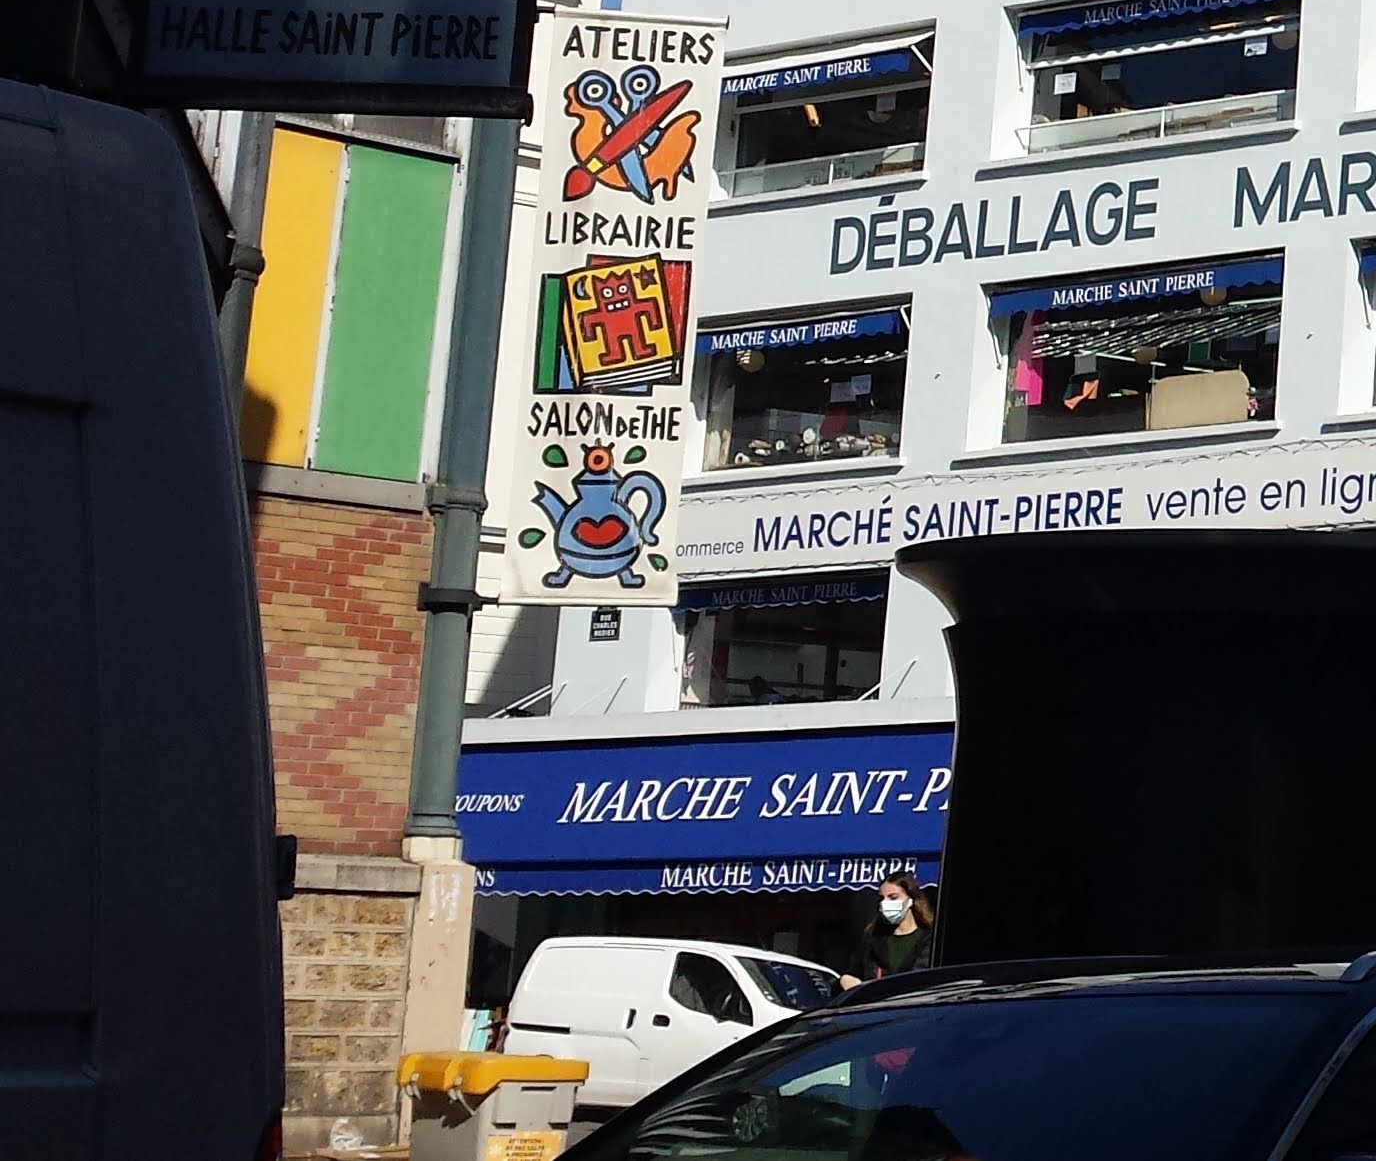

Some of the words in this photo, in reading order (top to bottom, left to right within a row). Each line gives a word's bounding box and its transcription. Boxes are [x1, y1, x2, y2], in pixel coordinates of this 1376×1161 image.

[161, 7, 273, 53] HALLE
[1084, 2, 1143, 24] MARCHE
[562, 24, 716, 67] ATELIERS
[724, 73, 778, 94] MARCHE
[784, 65, 821, 85] SAINT
[826, 58, 871, 79] PIERRE
[545, 211, 696, 250] LIBRAIRIE
[830, 179, 1159, 274] DÉBALLAGE
[1052, 282, 1113, 307] MARCHE
[1118, 276, 1160, 299] SAINT
[1165, 269, 1215, 293] PIERRE
[710, 326, 765, 350] MARCHE
[770, 321, 809, 342] SAINT
[813, 317, 857, 337] PIERRE
[527, 403, 614, 441] SALON
[639, 405, 681, 441] THE
[676, 539, 744, 557] ommerce
[753, 495, 893, 553] MARCHÉ
[903, 487, 1124, 541] SAINT-PIERRE
[1146, 481, 1248, 522] vente
[1260, 479, 1306, 512] en
[712, 589, 766, 606] MARCHE
[771, 586, 810, 602] SAINT
[814, 582, 857, 598] PIERRE
[556, 776, 751, 824] MARCHE
[759, 768, 952, 820] SAINT-P
[661, 862, 752, 888] MARCHE
